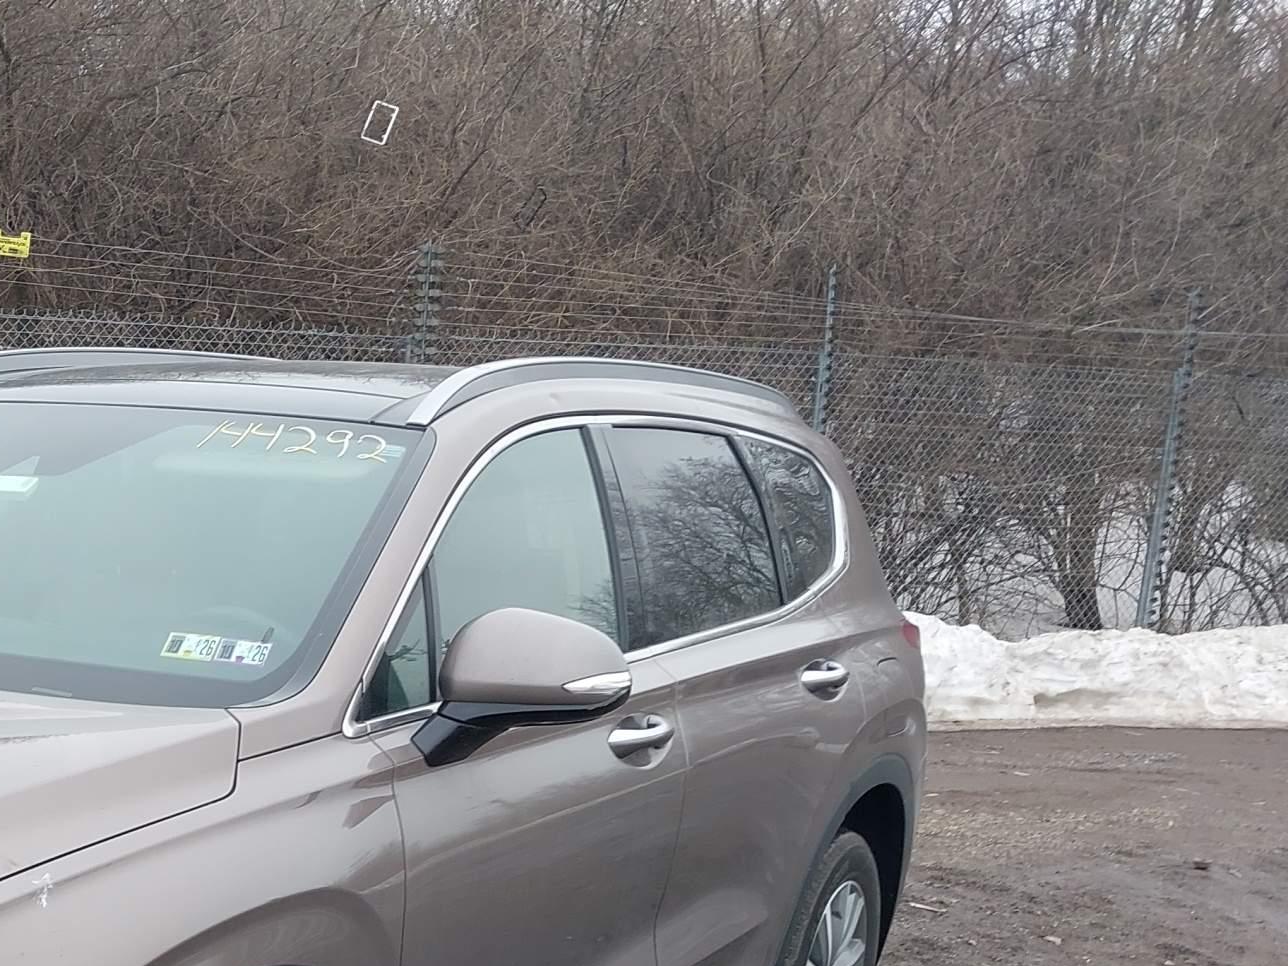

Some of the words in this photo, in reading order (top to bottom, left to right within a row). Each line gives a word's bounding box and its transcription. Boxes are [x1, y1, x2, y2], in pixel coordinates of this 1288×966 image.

[197, 420, 387, 462] 144292
[199, 639, 216, 656] 26
[220, 644, 235, 659] 10
[252, 645, 268, 662] 26
